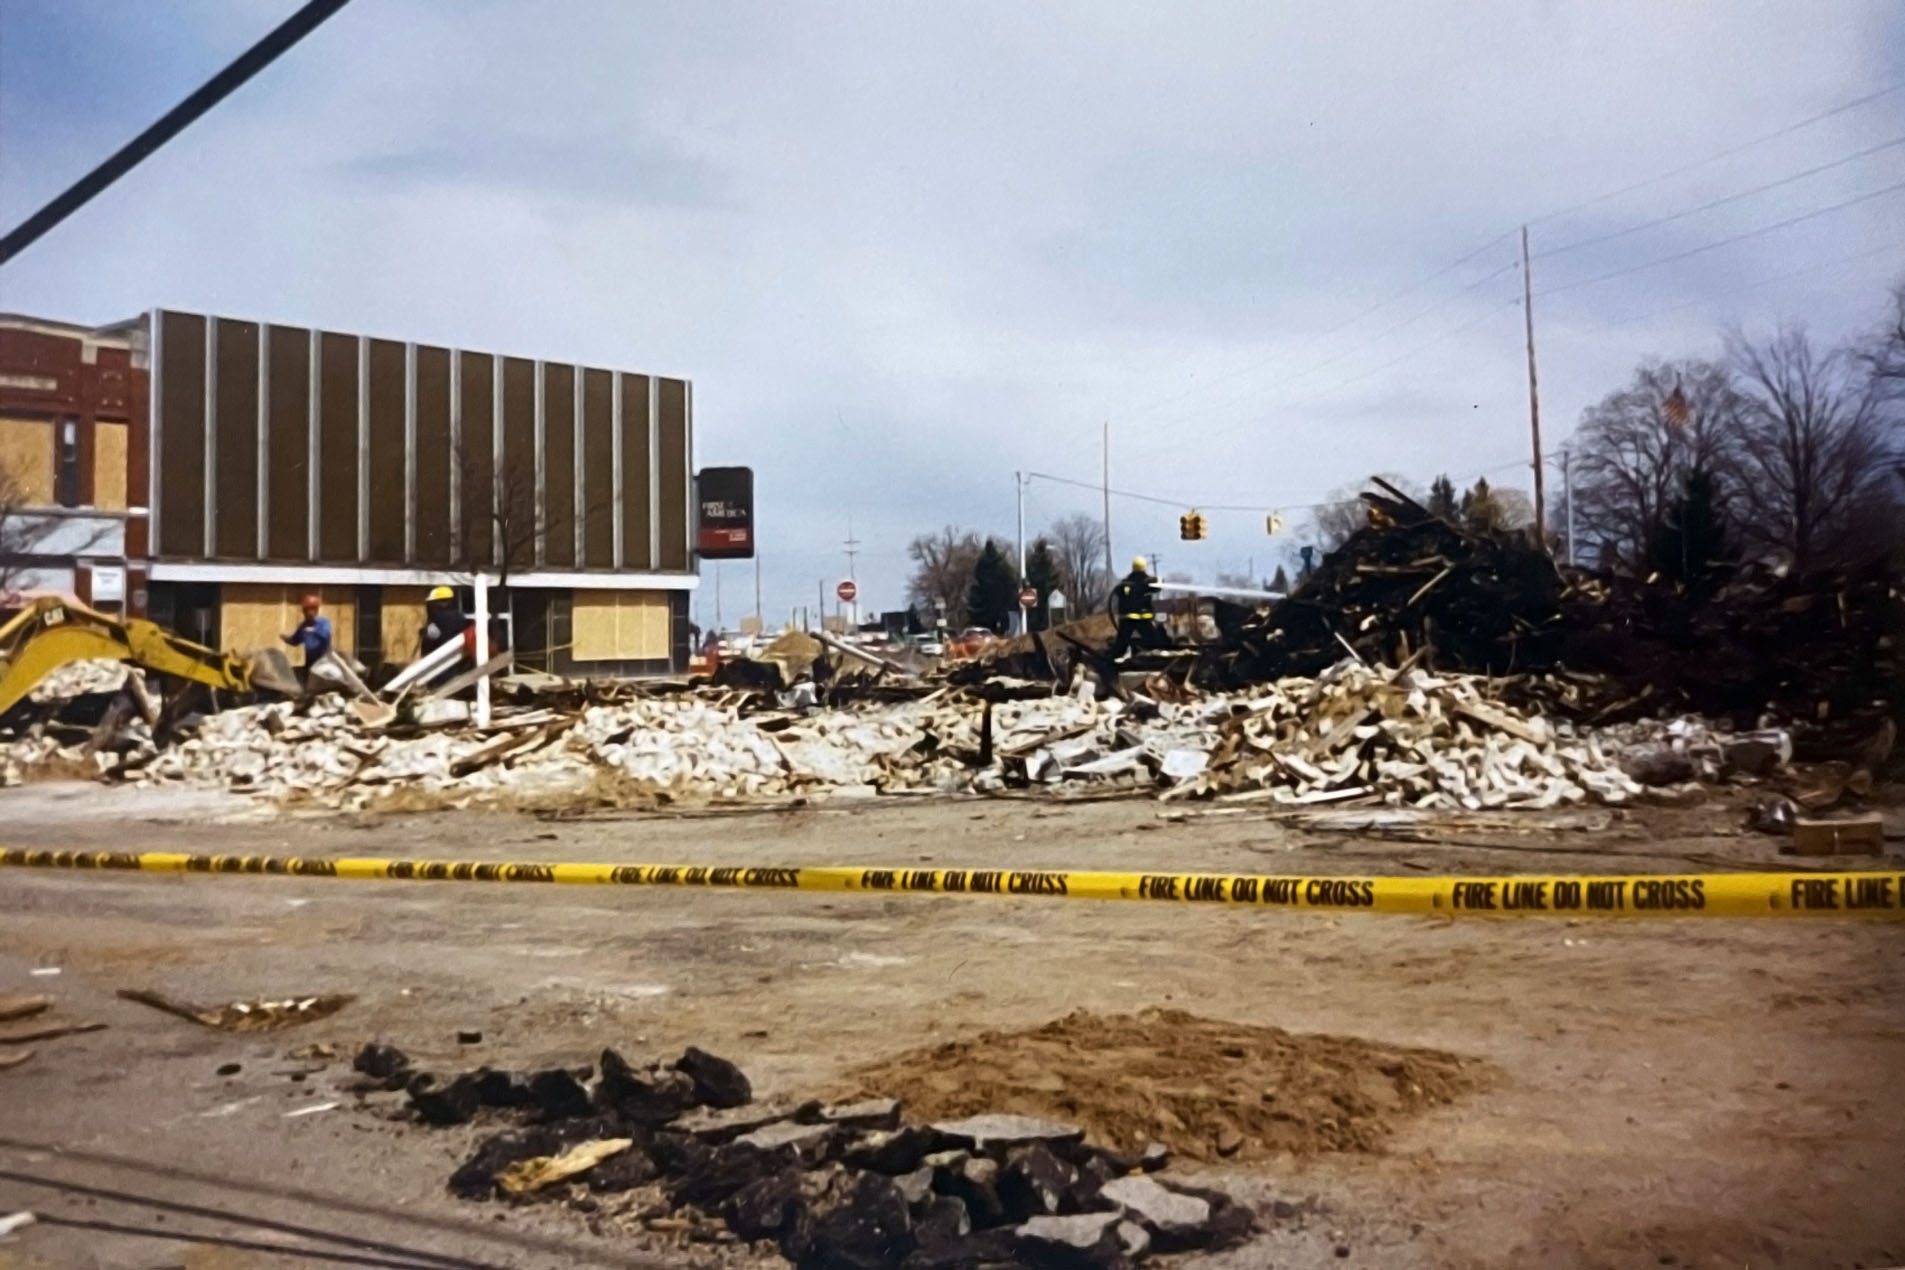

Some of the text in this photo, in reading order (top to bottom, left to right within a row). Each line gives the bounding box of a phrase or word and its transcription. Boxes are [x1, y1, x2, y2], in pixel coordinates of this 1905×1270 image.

[745, 868, 800, 888] CROSS
[861, 870, 1068, 896] FIRE LINE DO NOT CROSS
[1139, 875, 1374, 906] FIRE LINE DO NOT CROSS
[1791, 878, 1840, 909] FIRE
[1845, 877, 1894, 910] LINE
[1452, 879, 1705, 910] FIRE LINE DO NOT CROSS
